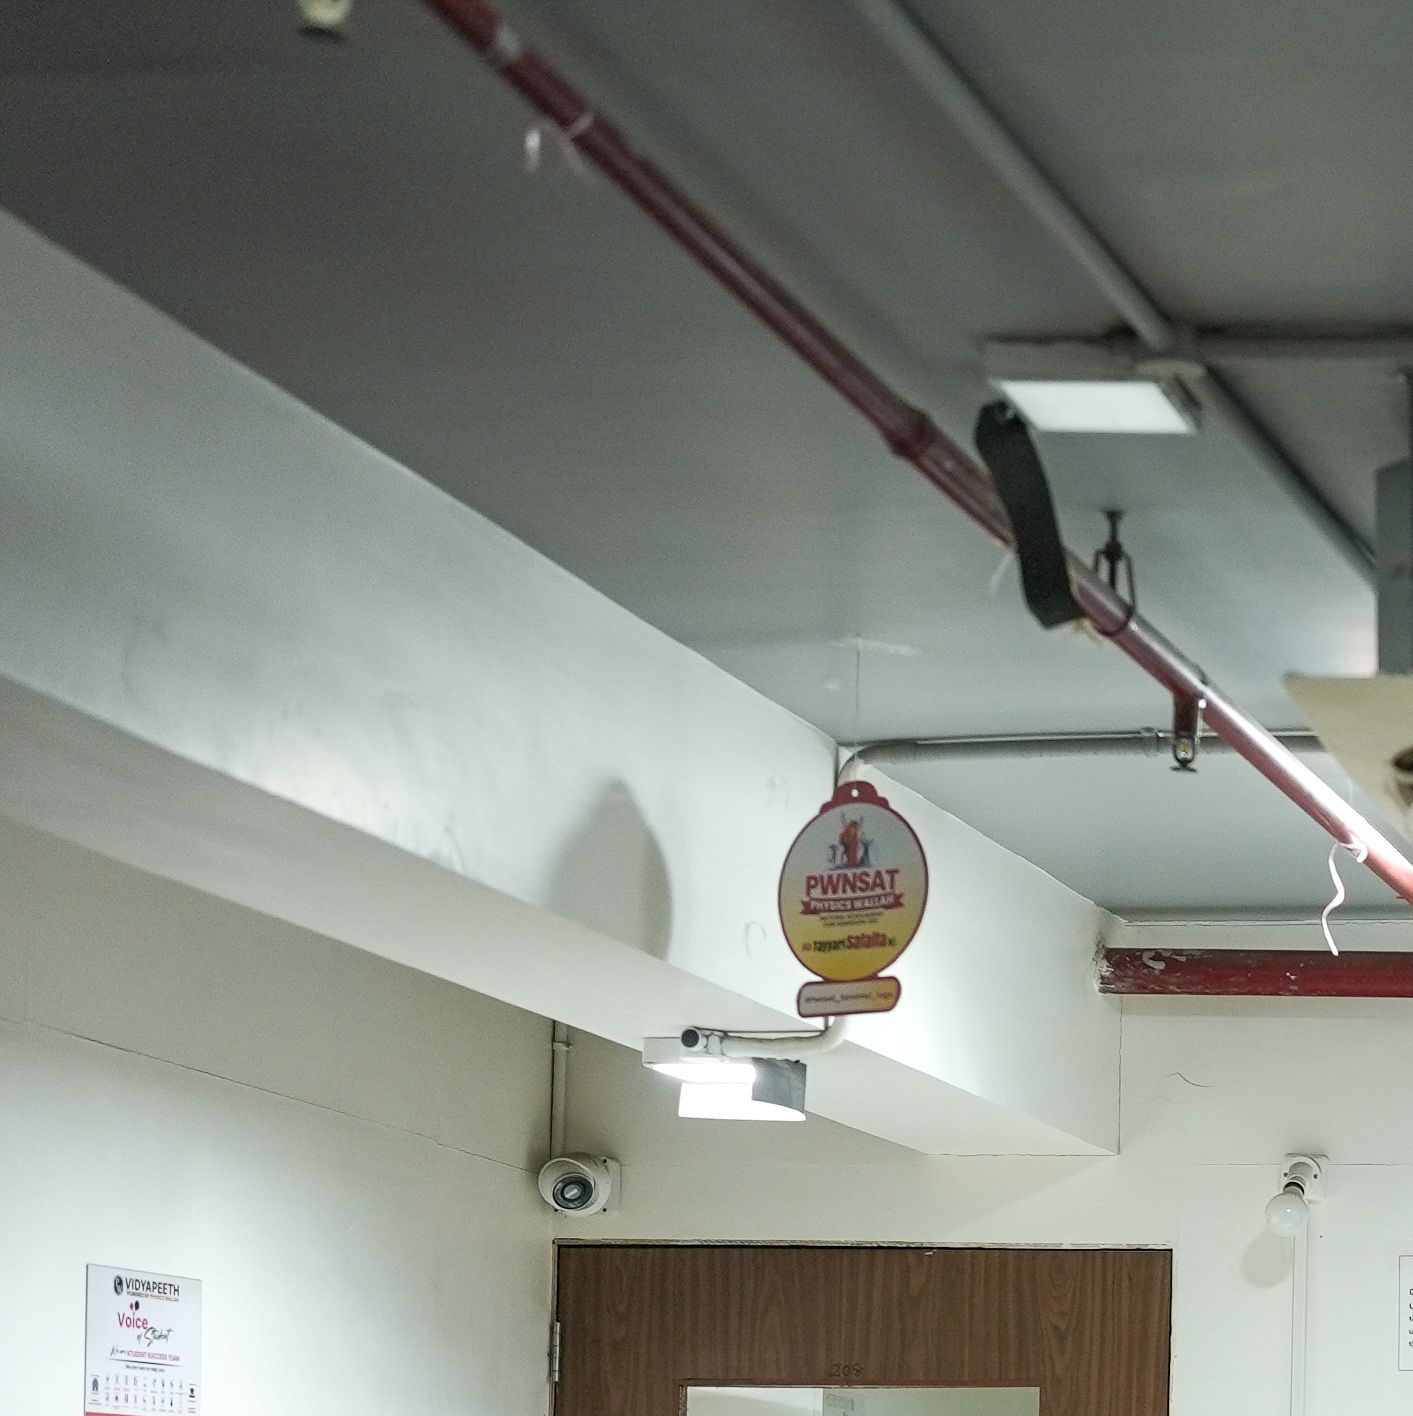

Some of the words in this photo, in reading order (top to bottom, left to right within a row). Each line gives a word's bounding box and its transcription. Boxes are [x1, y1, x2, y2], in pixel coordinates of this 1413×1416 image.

[806, 868, 899, 897] PWNSAT
[125, 1278, 180, 1296] VIDYAPEETH
[117, 1312, 149, 1330] Voice
